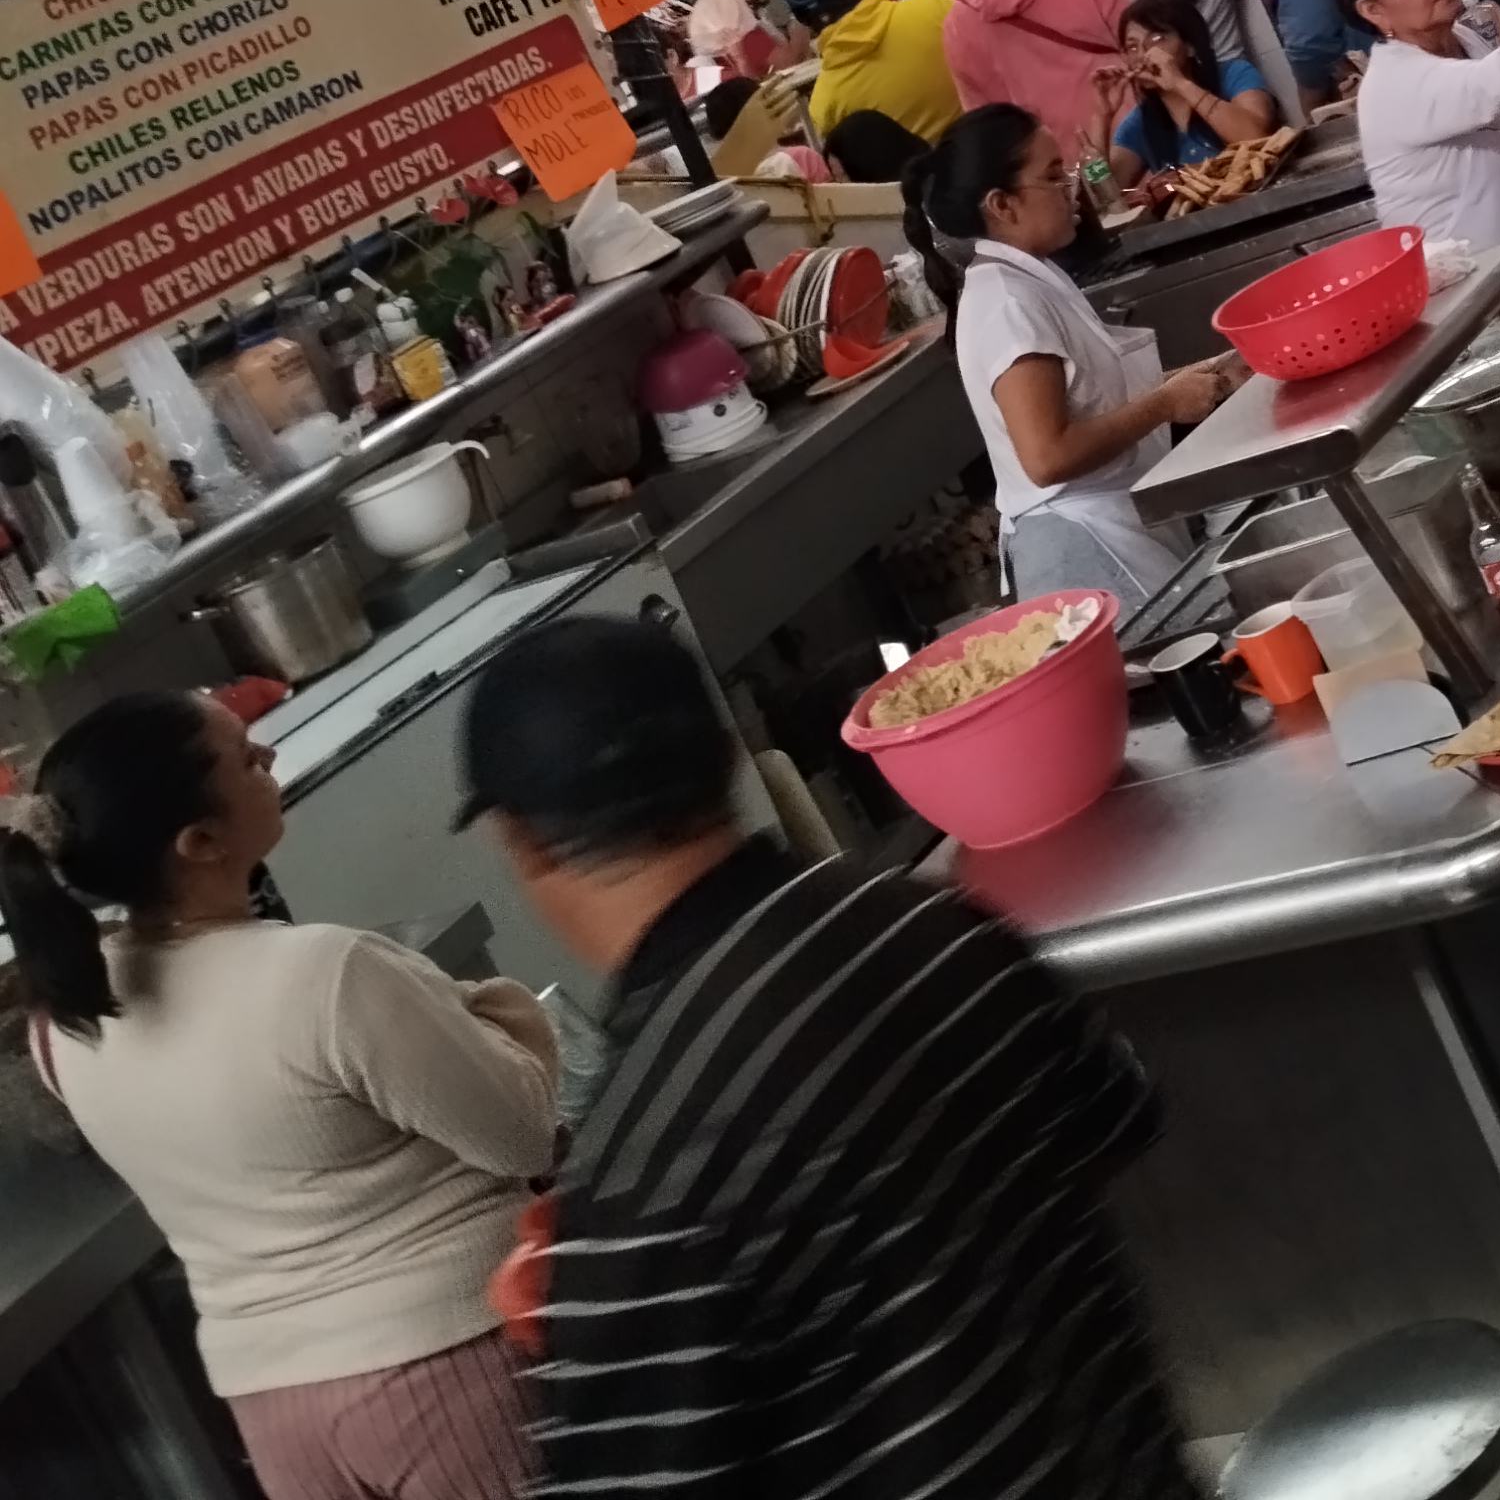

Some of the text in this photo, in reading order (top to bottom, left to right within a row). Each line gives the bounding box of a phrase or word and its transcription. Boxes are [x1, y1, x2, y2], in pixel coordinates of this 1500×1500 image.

[0, 11, 133, 81] CARNITAS
[22, 58, 110, 109] PAPAS
[116, 33, 174, 71] CON
[29, 16, 311, 150] PAPAS CON PICADILLO
[502, 78, 562, 128] RICO
[28, 71, 363, 234] NOPALITOS CON CAMARON
[68, 60, 300, 174] CHILES RELLENOS
[524, 118, 588, 170] MOLE
[16, 223, 175, 316] VERDURAS
[176, 193, 235, 242] SON
[235, 140, 347, 213] LAVADAS
[347, 129, 367, 157] Y
[369, 47, 552, 149] DESINFECTADAS.
[141, 143, 454, 316] ATENCION Y BUEN GUSTO.
